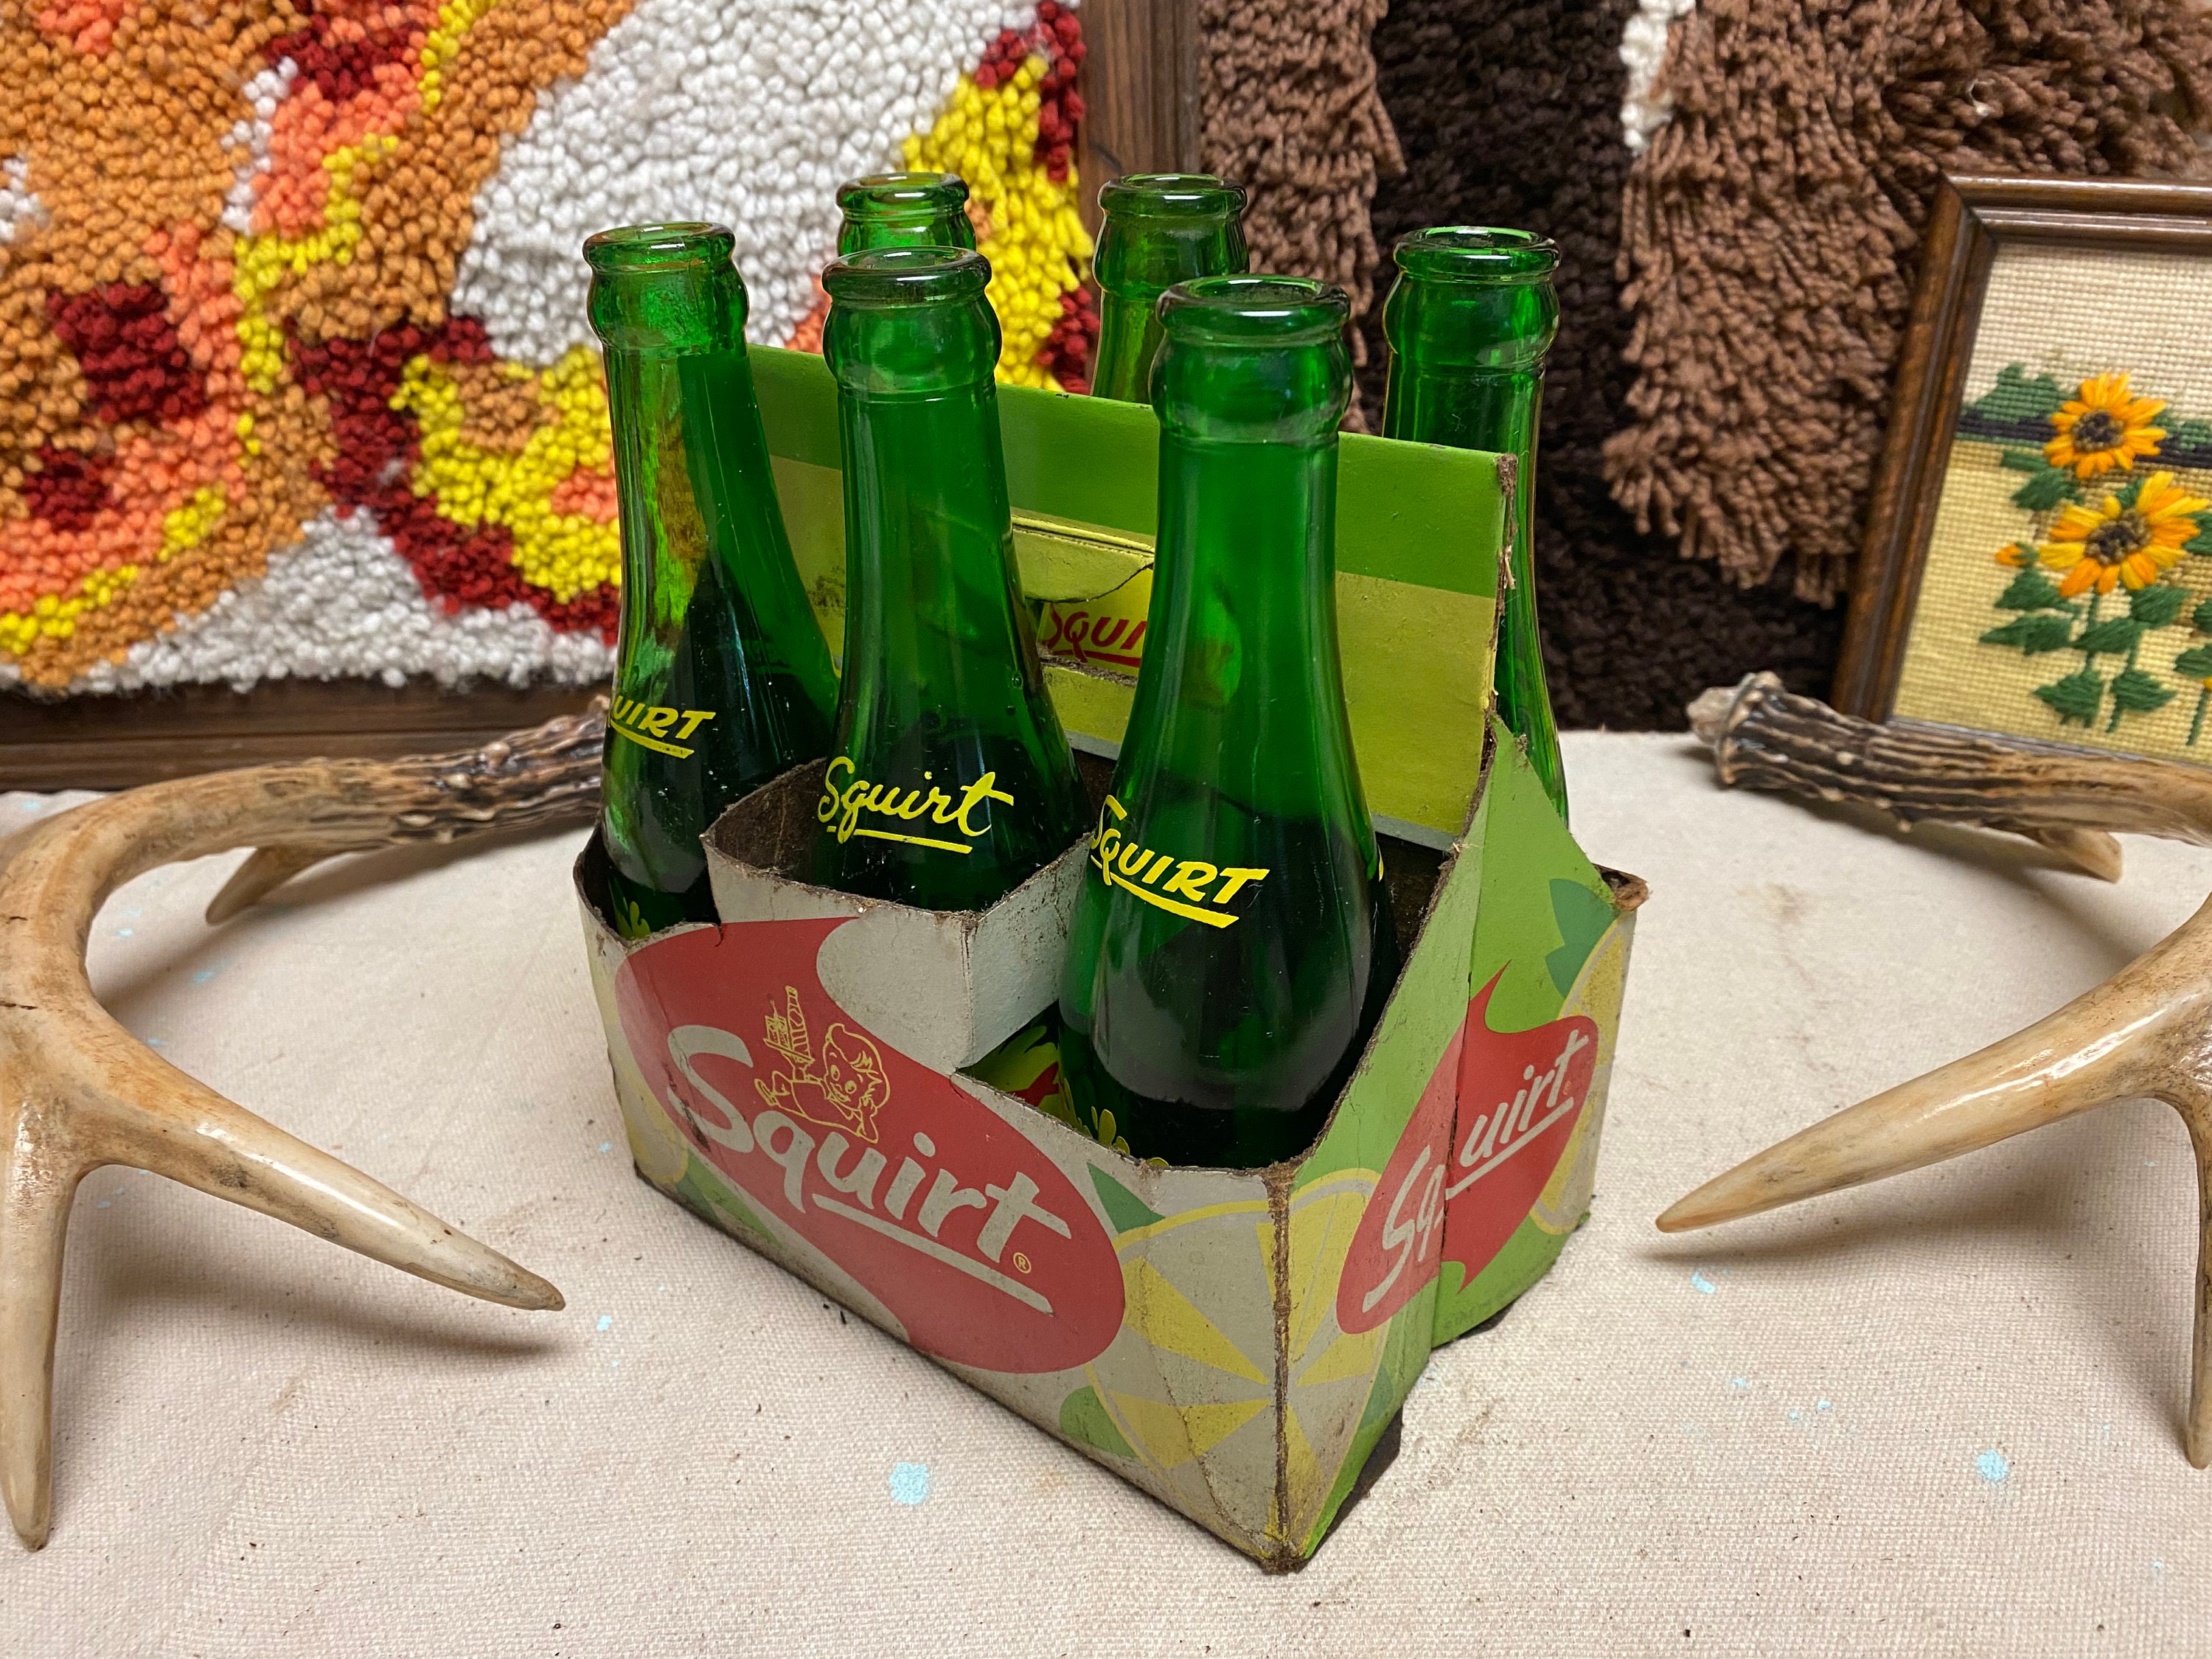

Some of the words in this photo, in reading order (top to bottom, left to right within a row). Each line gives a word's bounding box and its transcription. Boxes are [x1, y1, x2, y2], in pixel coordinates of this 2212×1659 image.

[1042, 603, 1147, 663] SQUI
[613, 695, 717, 740] UIRT
[818, 756, 1015, 843] Squirt
[1091, 794, 1270, 905] SQUIRT
[667, 1024, 1072, 1263] Squirt
